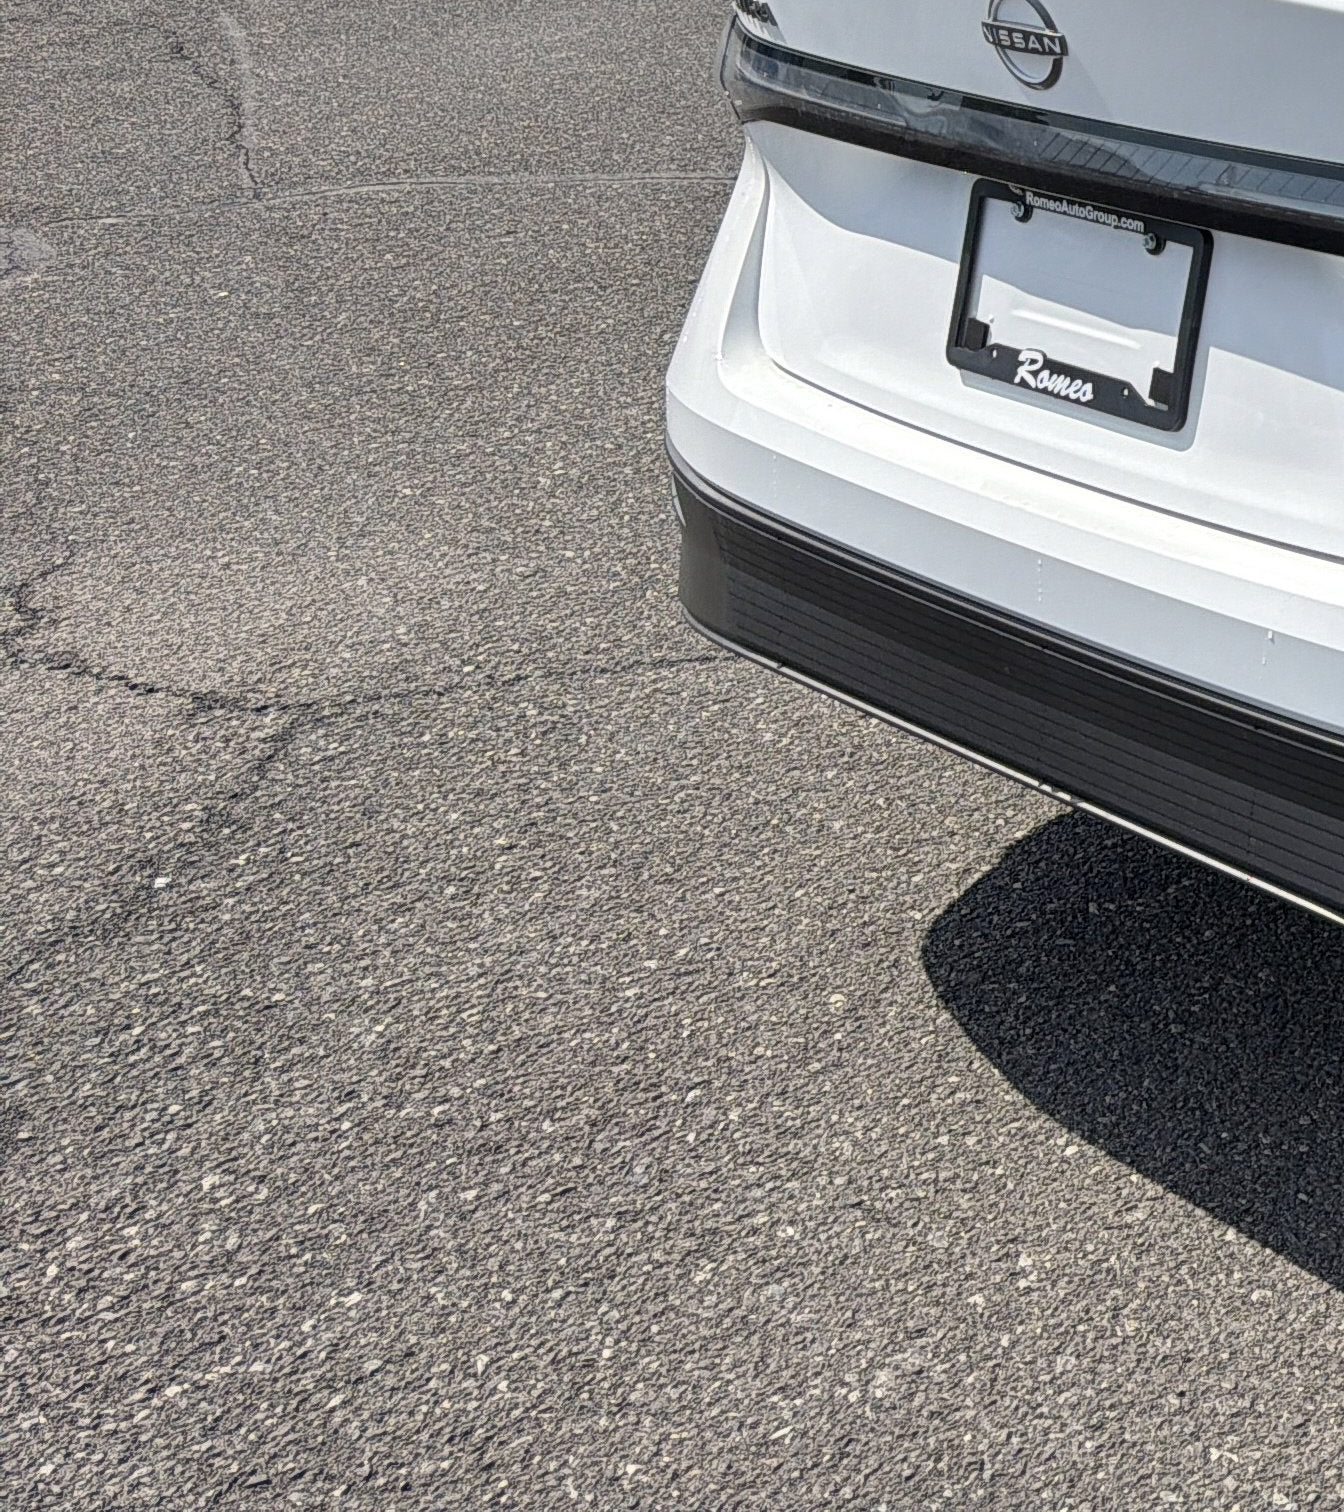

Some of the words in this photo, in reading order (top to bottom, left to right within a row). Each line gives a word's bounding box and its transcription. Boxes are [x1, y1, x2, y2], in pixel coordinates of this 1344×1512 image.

[982, 25, 1062, 54] NISSAN
[1025, 190, 1145, 233] RomeoAutoGroup.com
[1013, 349, 1094, 403] Romeo
